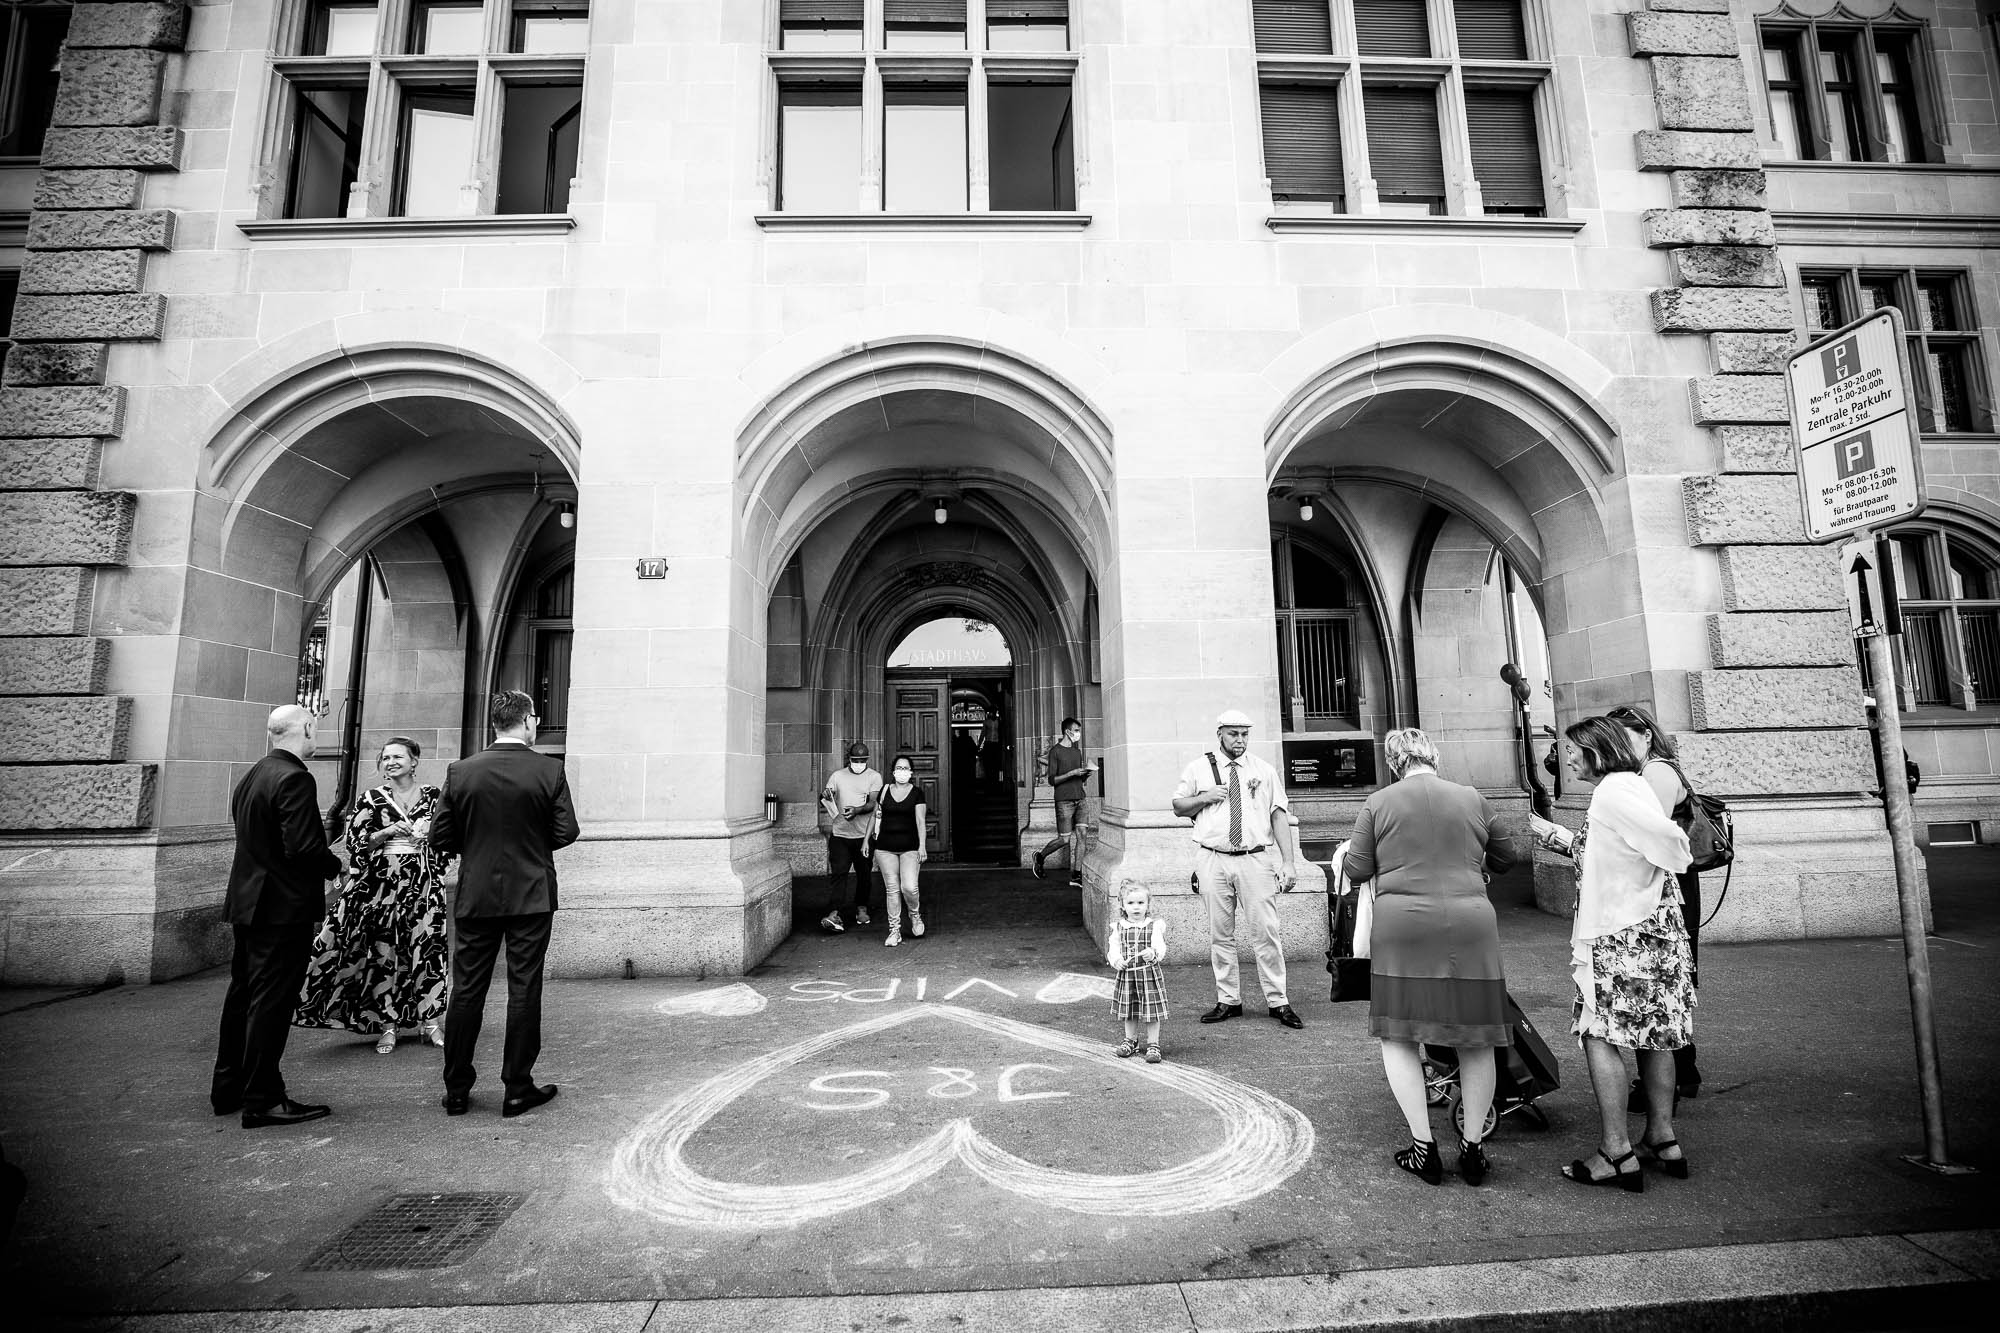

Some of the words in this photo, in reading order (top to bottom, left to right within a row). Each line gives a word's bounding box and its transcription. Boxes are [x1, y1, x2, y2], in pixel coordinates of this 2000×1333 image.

[1834, 344, 1847, 367] P
[1810, 391, 1831, 405] Mo-Fr
[1833, 367, 1882, 394] 16.30-20.00h
[1811, 406, 1820, 415] Sa
[1834, 378, 1884, 404] 12.00-20.00h
[1807, 408, 1848, 431] Zentrale
[1851, 389, 1892, 413] Parkuhr
[1829, 421, 1847, 432] max.
[1849, 416, 1854, 425] 2
[1855, 410, 1871, 422] Std.
[1844, 441, 1864, 472] P
[1822, 483, 1843, 497] Mo-Fr
[1844, 465, 1896, 489] 08.00-16.30h
[1824, 497, 1833, 506] Sa
[1845, 476, 1897, 499] 08.00-12.00h
[1830, 512, 1863, 528] während
[1864, 504, 1896, 519] Trauung
[1833, 505, 1845, 515] für
[1846, 494, 1889, 512] Brautpaare
[645, 561, 659, 576] 17
